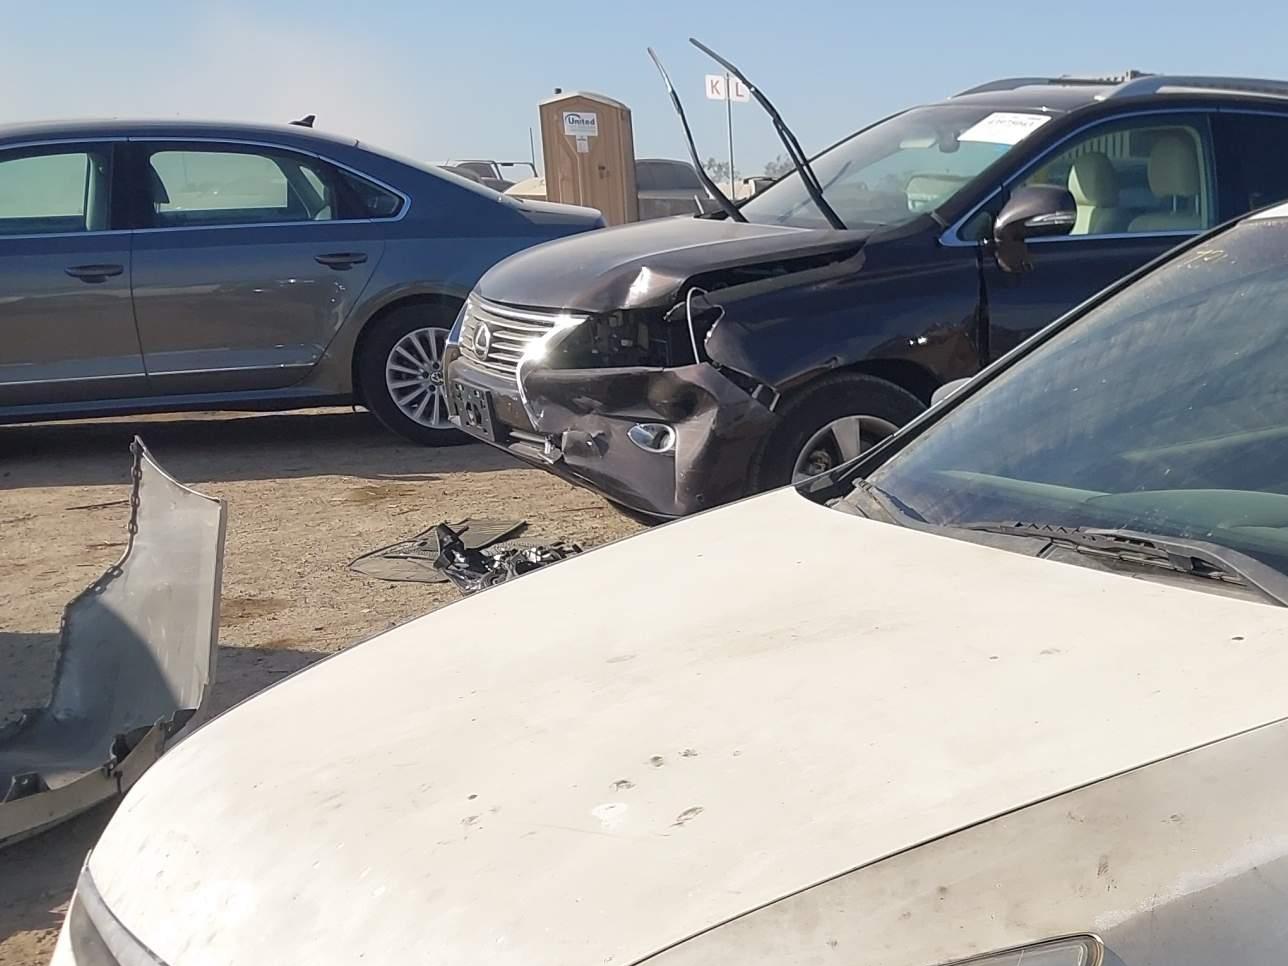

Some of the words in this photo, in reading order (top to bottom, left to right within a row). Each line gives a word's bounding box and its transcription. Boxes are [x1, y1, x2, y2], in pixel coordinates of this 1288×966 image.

[710, 79, 721, 96] K
[735, 81, 745, 98] L
[567, 116, 596, 126] United
